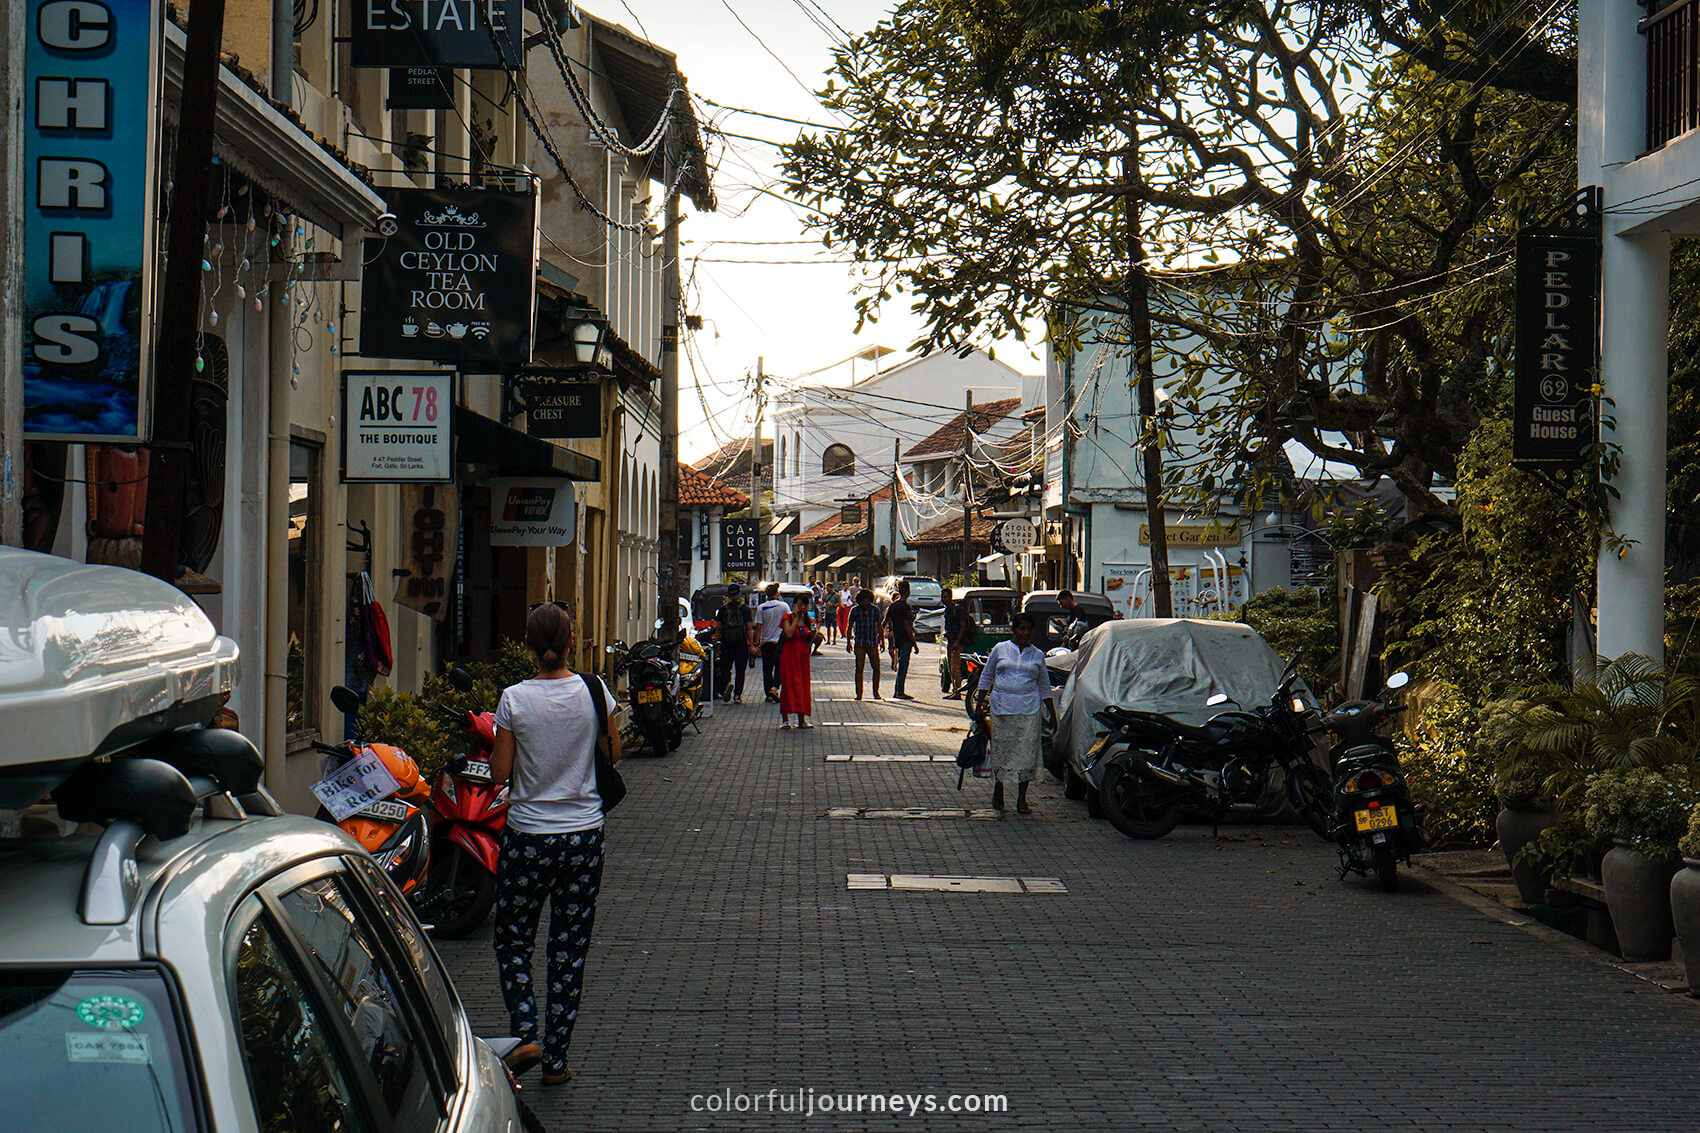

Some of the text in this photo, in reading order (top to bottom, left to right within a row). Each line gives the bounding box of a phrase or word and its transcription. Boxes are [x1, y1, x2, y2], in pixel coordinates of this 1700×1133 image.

[367, 0, 506, 30] ESTATE
[407, 68, 438, 76] PEDLAR
[407, 77, 436, 85] STREET
[33, 0, 112, 365] CHRIS
[425, 231, 475, 250] OLD
[400, 251, 498, 272] CEYLON
[426, 272, 473, 291] TEA
[410, 290, 486, 310] ROOM
[1541, 251, 1573, 372] PEDLAR
[1542, 380, 1566, 396] 62
[360, 386, 438, 422] ABC 78
[533, 409, 564, 420] CHEST
[1532, 406, 1576, 422] Guest
[360, 434, 438, 444] THE BOUTIQUE
[1530, 423, 1577, 439] House
[508, 496, 552, 509] UnionPay
[528, 526, 546, 535] Your
[548, 526, 567, 537] Way
[727, 537, 755, 547] LOR
[320, 760, 379, 799] Bike for
[346, 783, 383, 809] Rent
